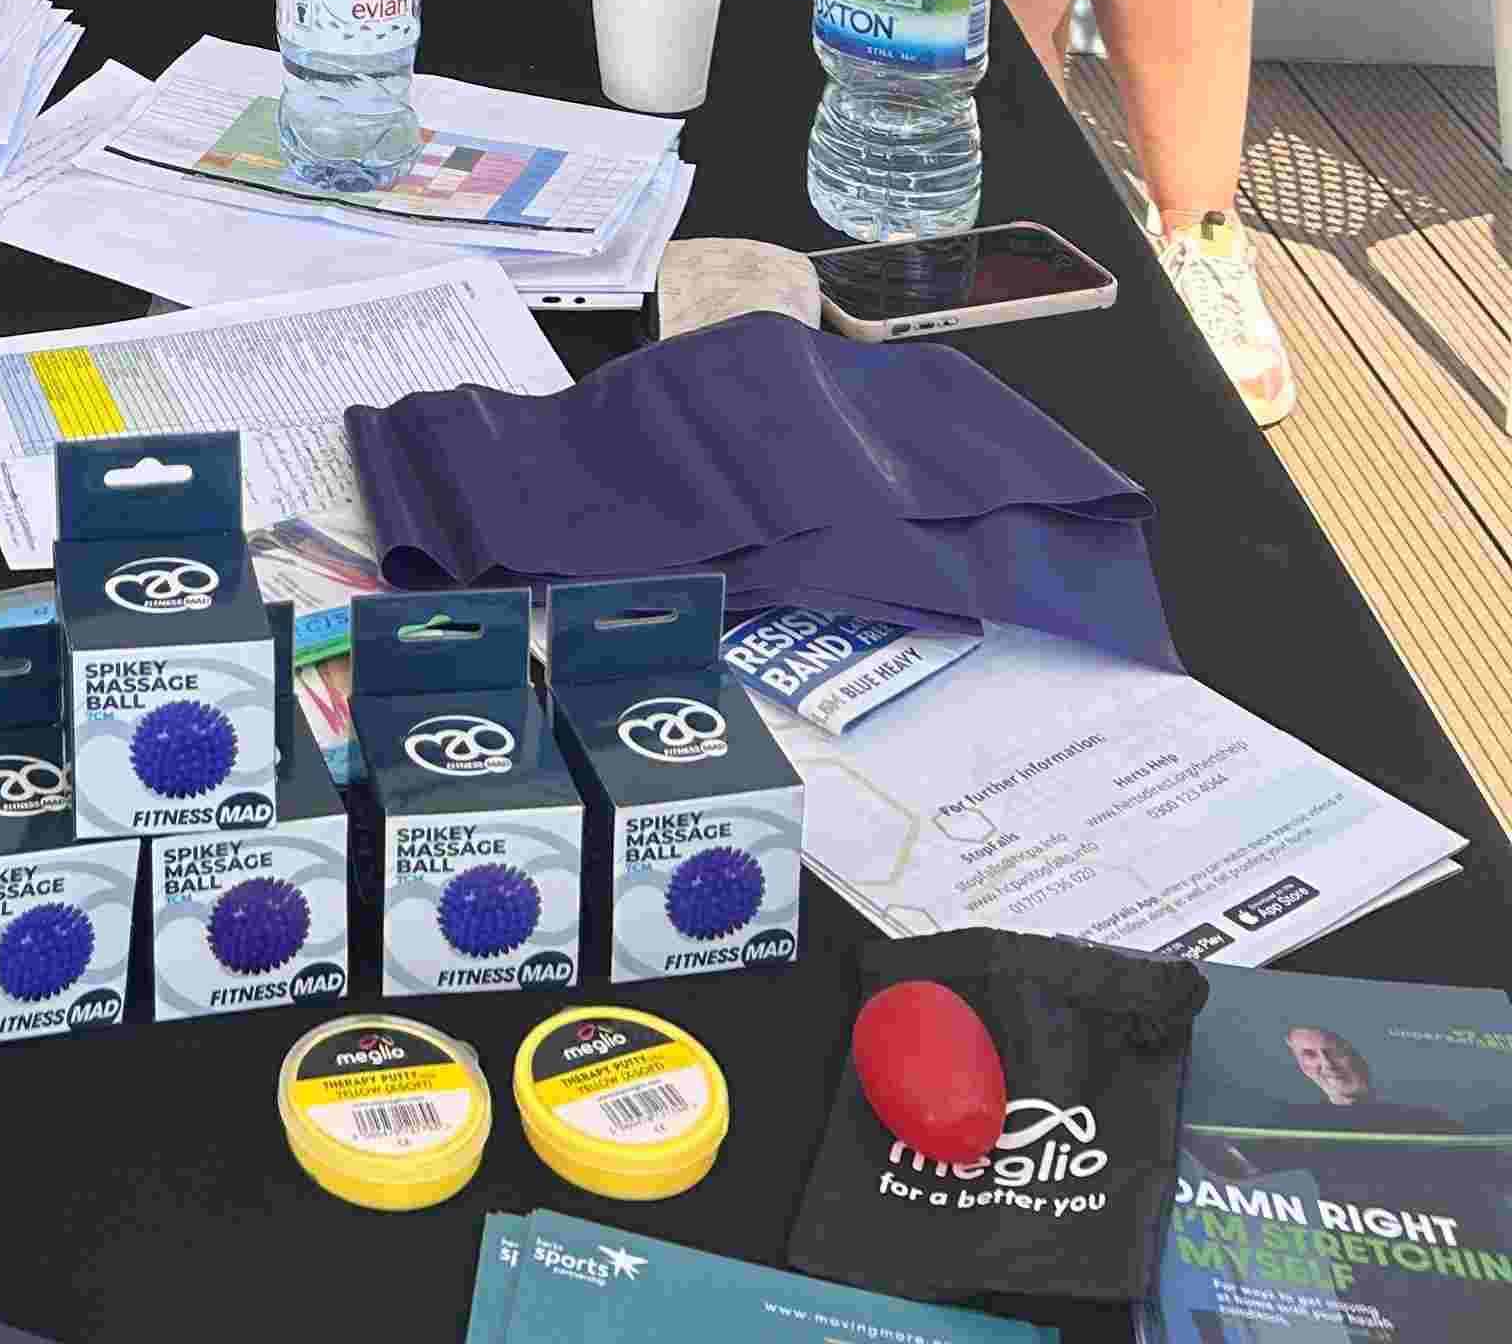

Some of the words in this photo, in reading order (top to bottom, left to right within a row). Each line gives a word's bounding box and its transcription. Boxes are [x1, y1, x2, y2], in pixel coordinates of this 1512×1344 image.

[85, 660, 168, 680] SPIKEY
[760, 634, 854, 697] BAND
[839, 672, 881, 700] BLUE
[879, 646, 924, 681] HEAVY
[86, 674, 199, 695] MASSAGE
[87, 693, 146, 711] BALL
[1112, 765, 1152, 789] Herts
[1144, 751, 1180, 771] Help
[938, 801, 969, 818] For
[964, 774, 1020, 806] further
[133, 807, 215, 828] FITNESS
[219, 803, 273, 825] MAD
[626, 812, 704, 834] SPIKEY
[396, 825, 478, 844] SPIKEY
[625, 822, 733, 849] MASSAGE
[164, 839, 244, 864] SPIKEY
[396, 839, 507, 858] MASSAGE
[625, 844, 682, 864] BALL
[165, 851, 273, 881] MASSAGE
[396, 857, 455, 875] BALL
[166, 875, 223, 895] BALL
[1257, 900, 1282, 919] App
[1277, 886, 1310, 908] Store
[665, 947, 740, 971] FITNESS
[745, 941, 794, 962] MAD
[437, 967, 517, 988] FITNESS
[521, 963, 571, 983] MAD
[211, 981, 288, 1007] FITNESS
[294, 973, 343, 996] MAD
[70, 998, 119, 1024] MAD
[336, 1043, 405, 1066] meglio
[562, 1031, 627, 1062] meglio
[322, 1075, 376, 1089] THERAPY
[561, 1065, 612, 1087] THERAPY
[879, 1171, 924, 1201] for
[928, 1191, 949, 1207] a
[957, 1188, 1048, 1213] better
[1054, 1192, 1107, 1218] you
[1317, 1199, 1458, 1248] RIGHT
[533, 1246, 610, 1279] sports
[1175, 1234, 1358, 1296] MYSELF
[764, 1300, 954, 1344] www.movingmore.
